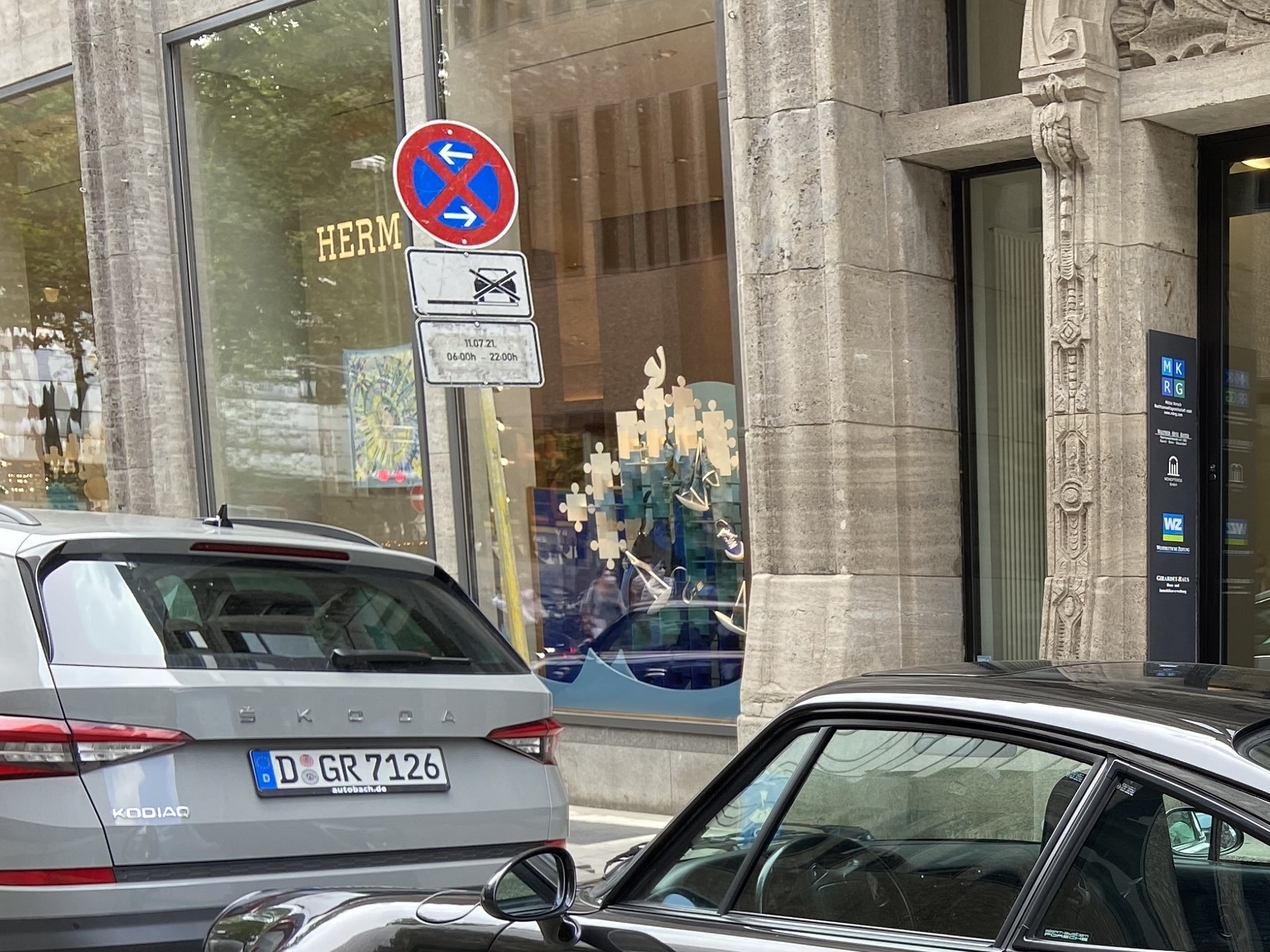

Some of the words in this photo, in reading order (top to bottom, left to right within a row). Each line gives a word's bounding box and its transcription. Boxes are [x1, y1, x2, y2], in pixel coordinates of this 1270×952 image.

[316, 212, 402, 262] HERM
[447, 352, 476, 361] 06:00h
[489, 352, 518, 361] 22:00h
[1163, 517, 1183, 531] WZ
[275, 755, 299, 784] D
[319, 754, 362, 782] GR
[365, 753, 440, 781] 7126
[262, 774, 270, 783] D
[331, 785, 387, 794] autobach.de
[112, 805, 190, 819] KODIAQ
